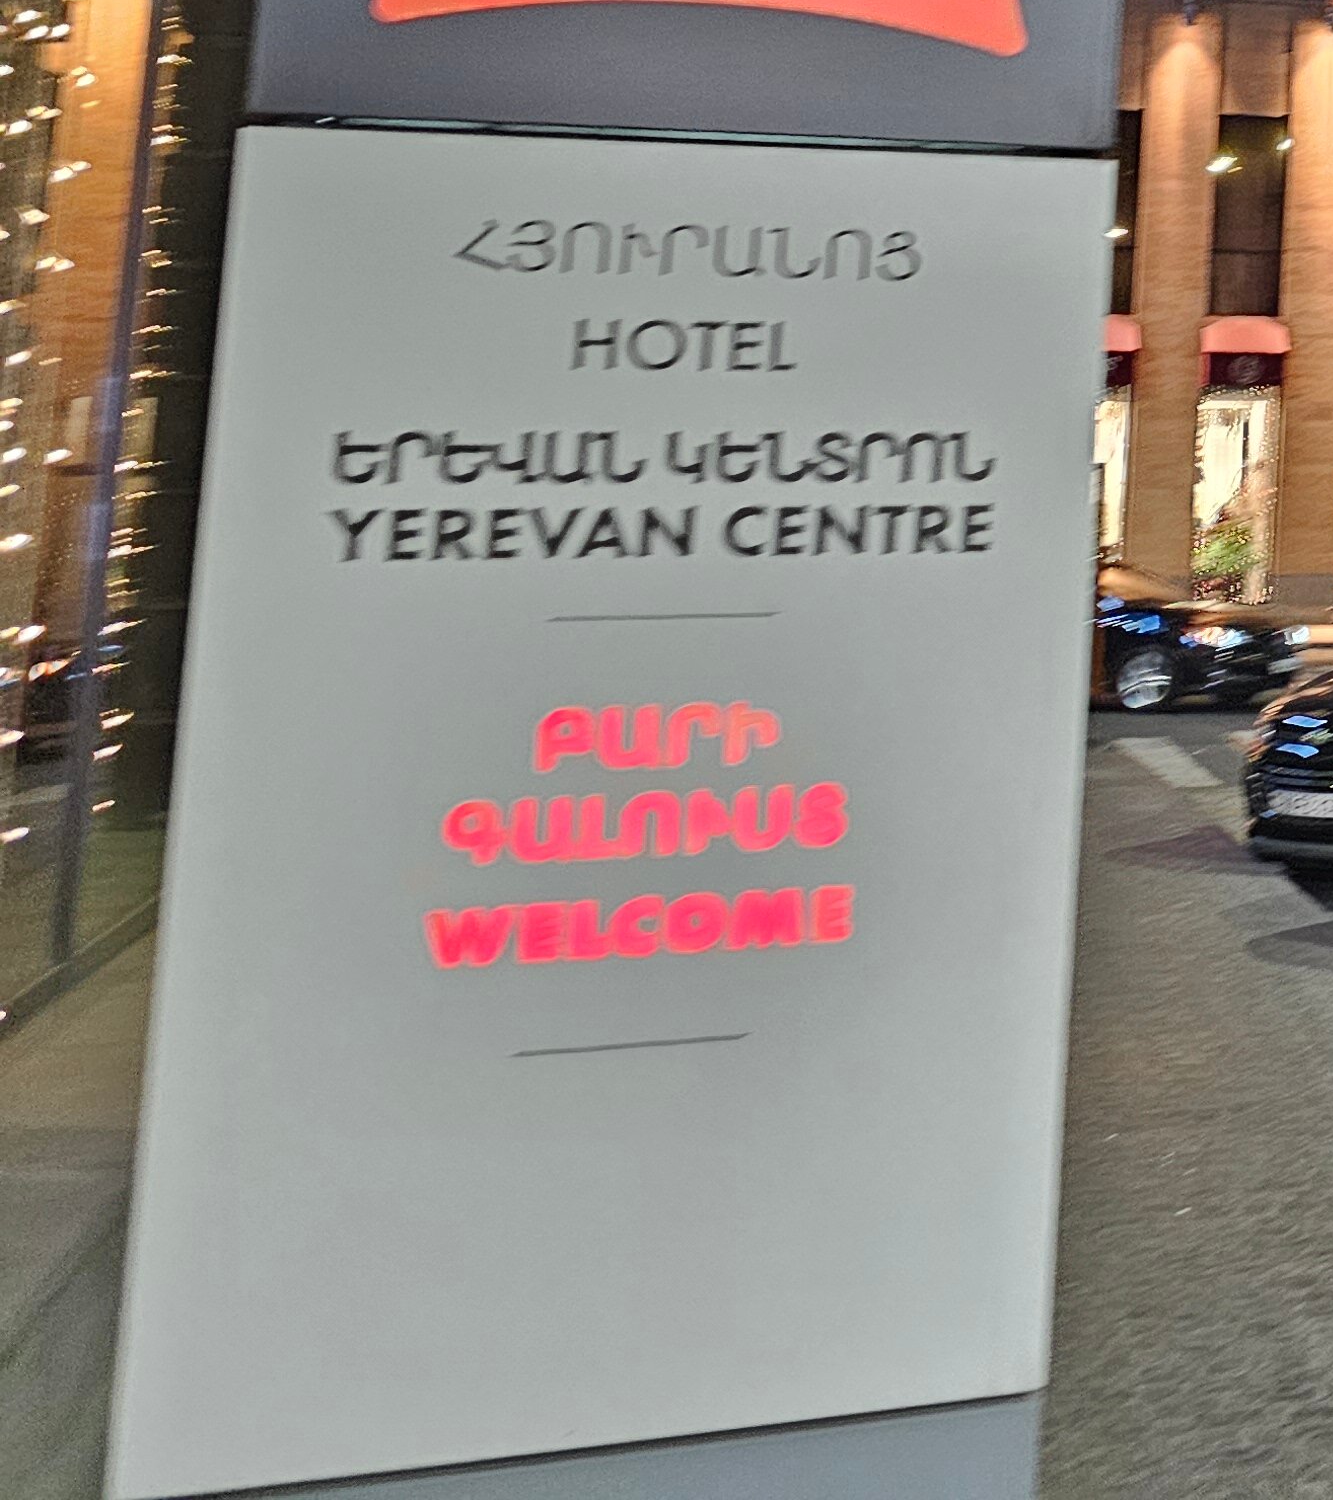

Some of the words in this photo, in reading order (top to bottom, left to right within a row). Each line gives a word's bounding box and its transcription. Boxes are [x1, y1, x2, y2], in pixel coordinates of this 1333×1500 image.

[453, 218, 922, 282] ՀՅՈՒՐԱՆՈՑ
[568, 317, 798, 373] HOTEL
[330, 430, 648, 486] ԵՐԵՎԱՆ
[666, 430, 997, 485] ԿԵՆՏՐՈՆ
[326, 505, 702, 563] YEREVAN
[721, 502, 997, 557] CENTRE
[533, 701, 781, 773] ԲԱՐԻ
[424, 884, 856, 969] WELCOME
